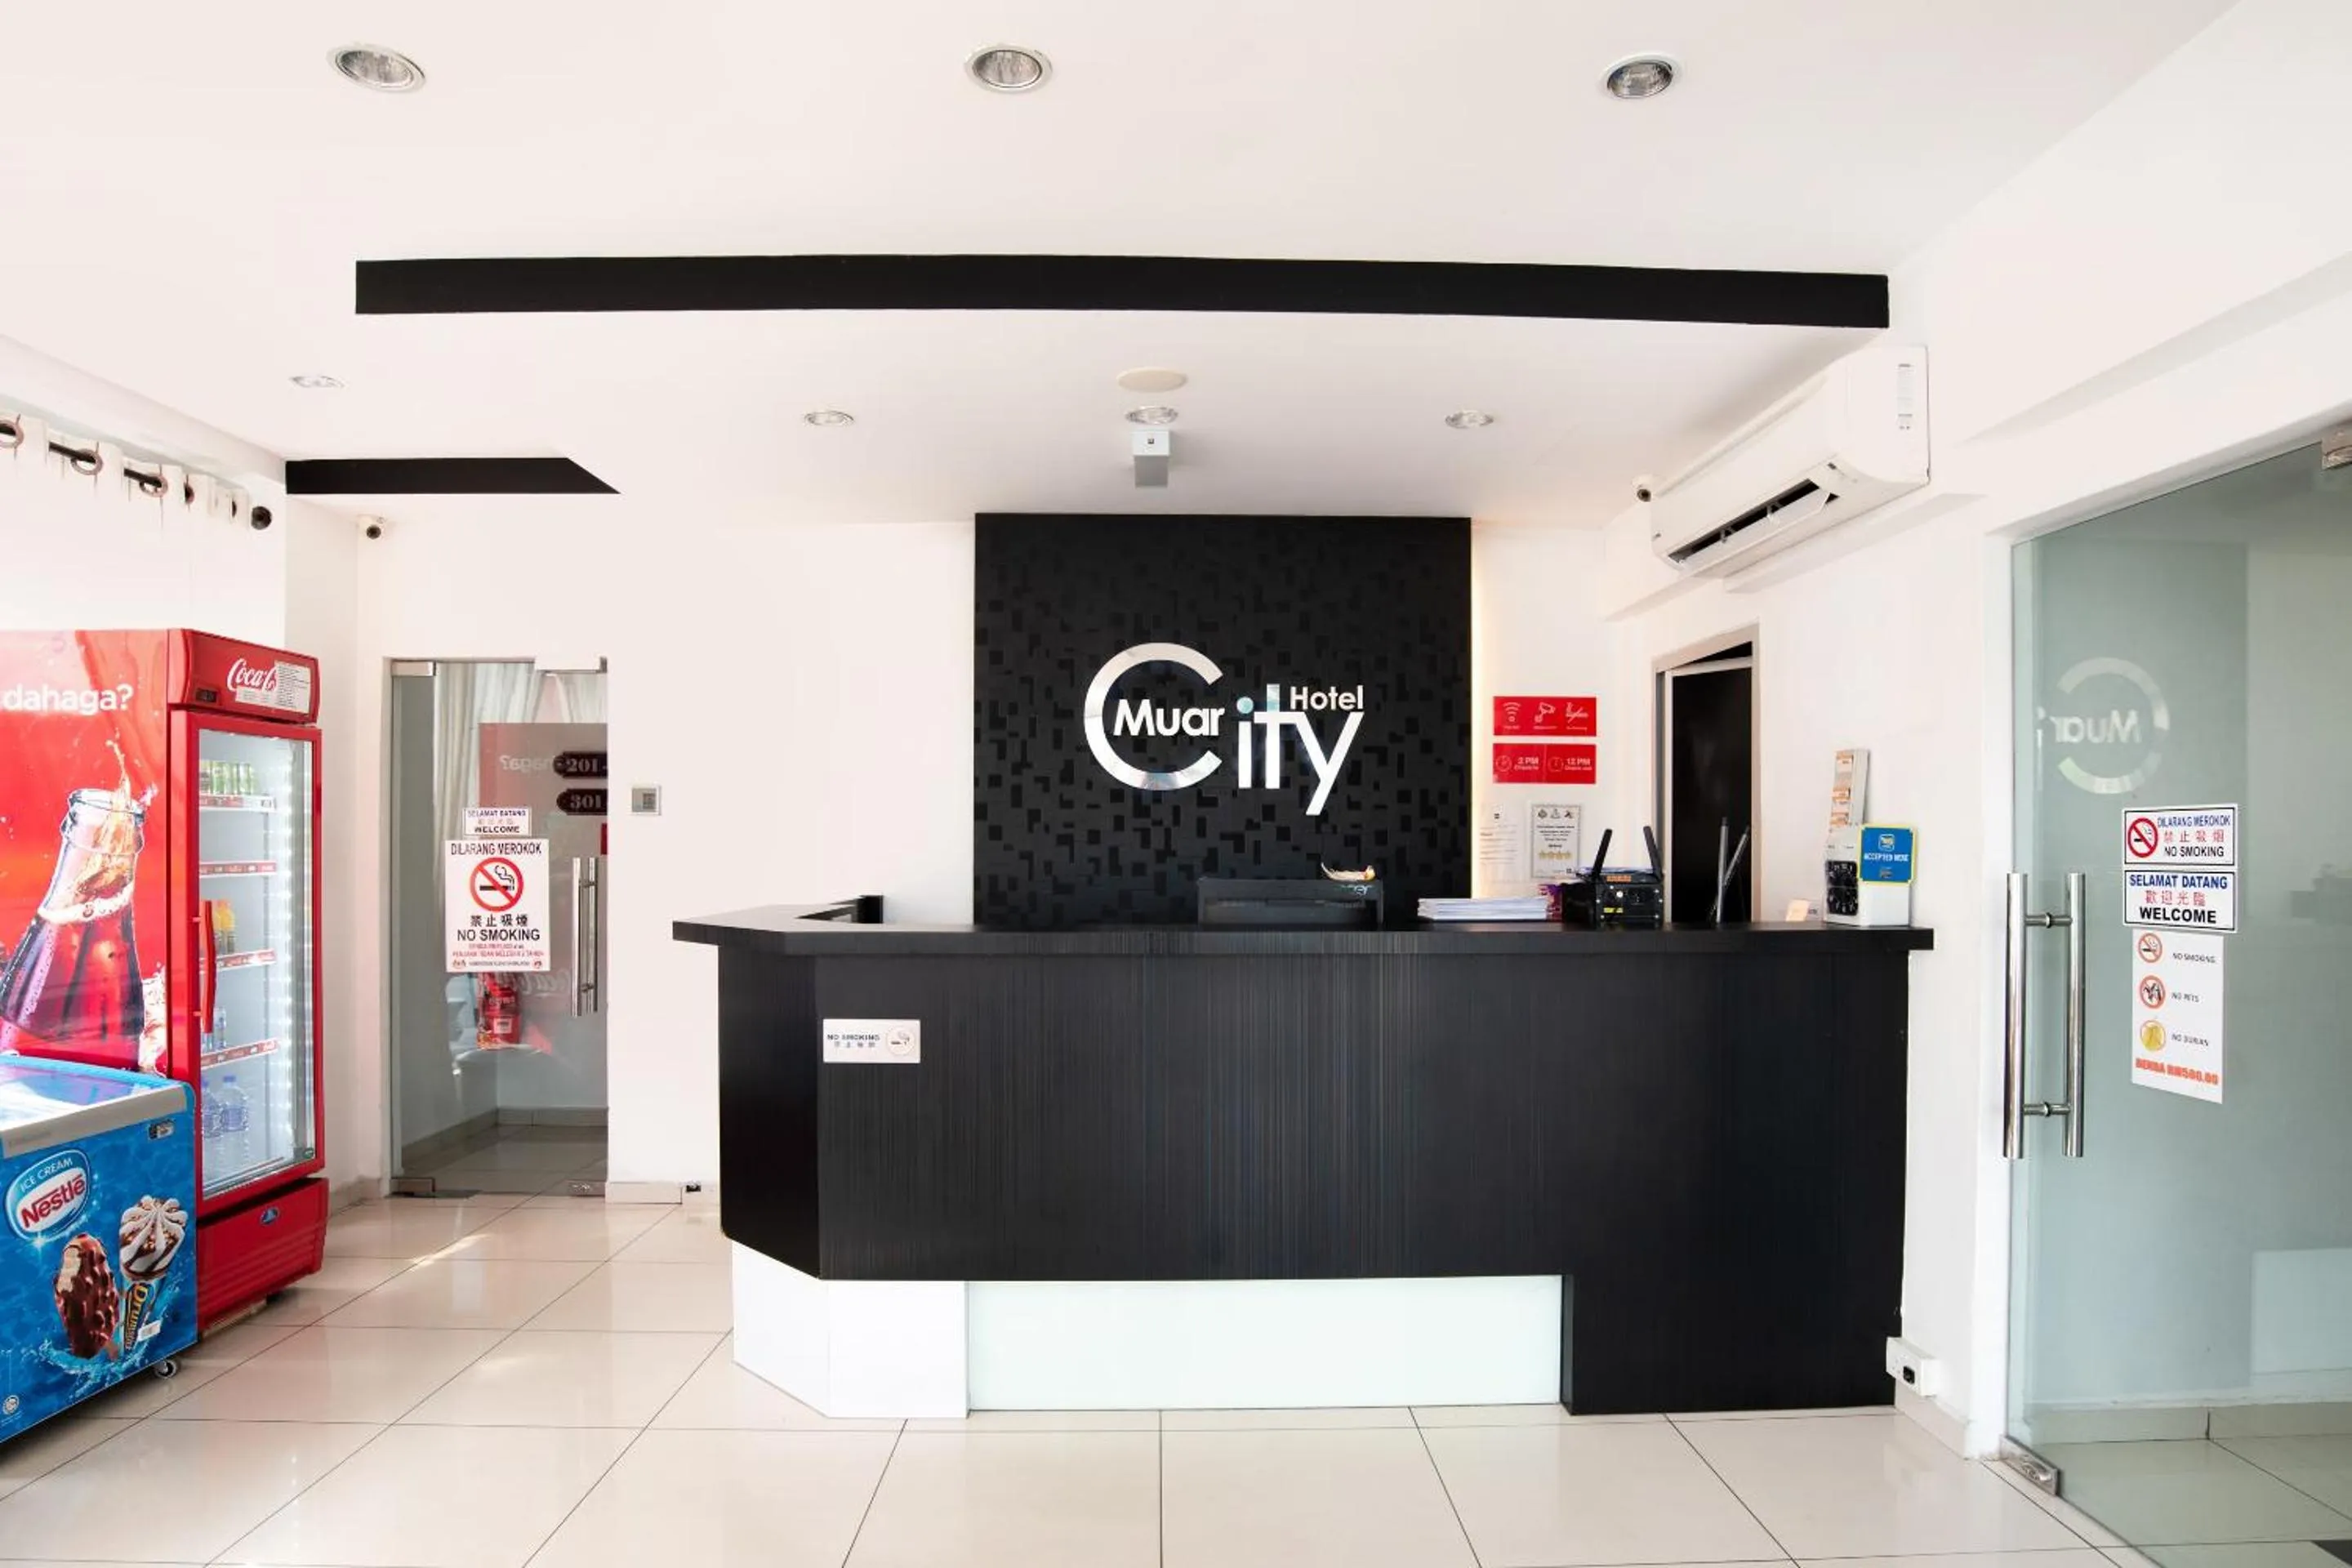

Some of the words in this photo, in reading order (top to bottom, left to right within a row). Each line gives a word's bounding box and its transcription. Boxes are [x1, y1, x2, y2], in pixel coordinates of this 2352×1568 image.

[2, 684, 134, 716] dahaga?
[1290, 685, 1364, 710] Hotel
[1113, 698, 1225, 736] Muar
[1084, 642, 1365, 816] City
[2157, 816, 2192, 827] DILARANG
[2193, 815, 2230, 826] MEROKOK
[451, 843, 496, 855] DILARANG
[497, 842, 542, 855] MEROKOK
[2164, 846, 2177, 857] NO
[2180, 846, 2224, 857] SMOKING
[2130, 874, 2178, 887] SELAMAT
[2182, 875, 2228, 889] DATANG
[2139, 906, 2216, 924] WELCOME
[457, 929, 476, 942] NO
[479, 929, 540, 942] SMOKING
[2172, 952, 2183, 960] NO
[2184, 953, 2216, 964] SMOKING
[2172, 991, 2182, 1000] NO
[2184, 993, 2199, 1003] PETS
[2172, 1033, 2182, 1042] NO
[20, 1175, 37, 1192] ICE
[38, 1157, 73, 1180] CREAM
